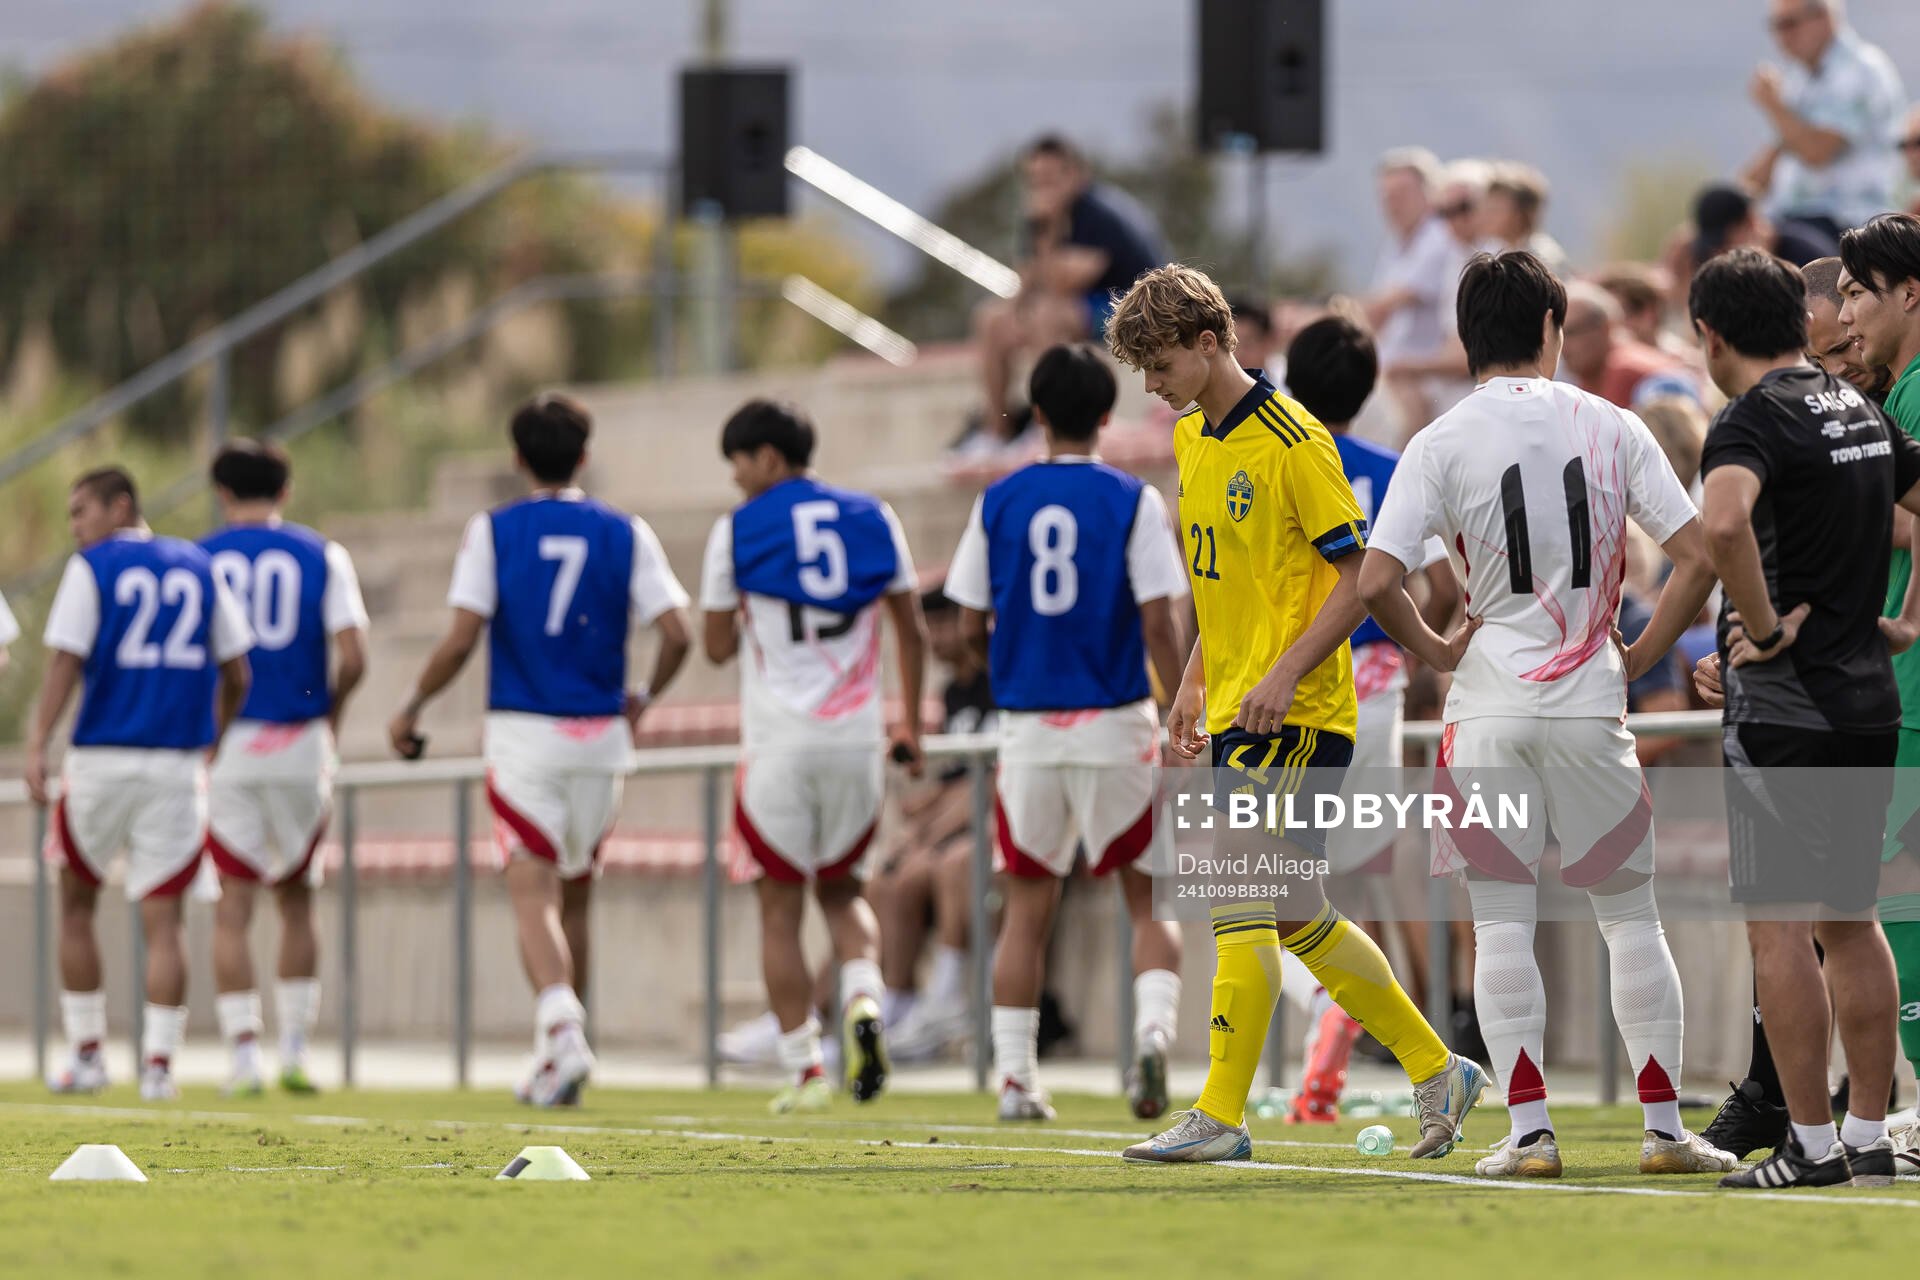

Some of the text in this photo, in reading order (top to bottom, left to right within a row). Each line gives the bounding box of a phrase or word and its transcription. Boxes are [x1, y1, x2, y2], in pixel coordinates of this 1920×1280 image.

[791, 500, 849, 600] 5
[1028, 504, 1079, 617] 8
[1191, 523, 1220, 580] 21
[1501, 456, 1591, 594] 11
[114, 565, 206, 670] 22
[538, 535, 589, 637] 7
